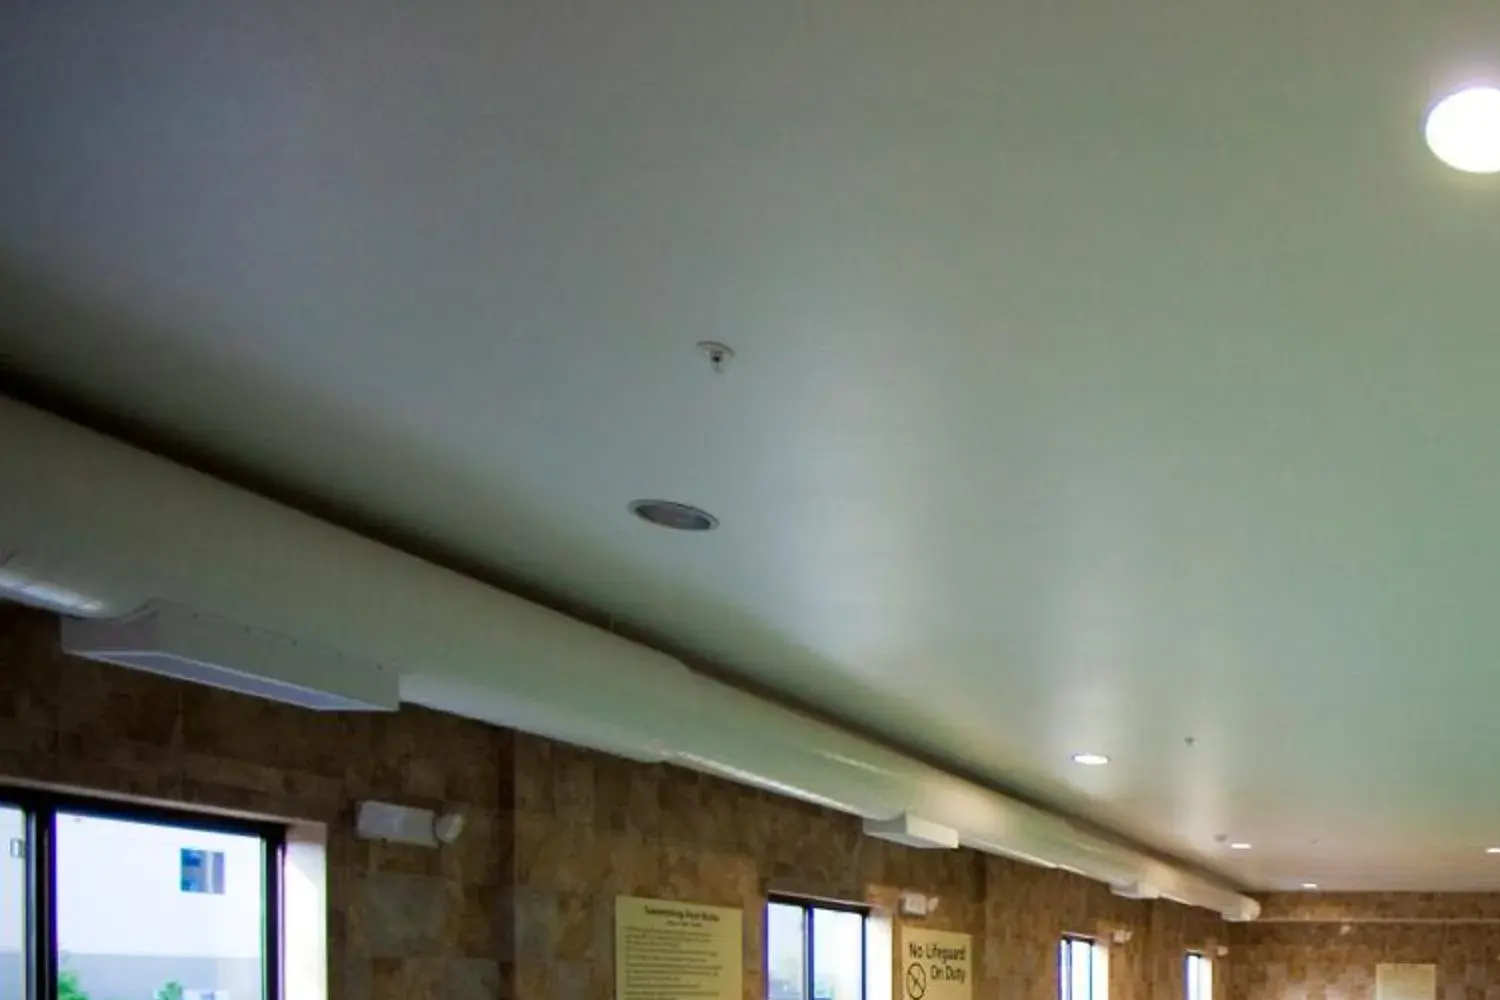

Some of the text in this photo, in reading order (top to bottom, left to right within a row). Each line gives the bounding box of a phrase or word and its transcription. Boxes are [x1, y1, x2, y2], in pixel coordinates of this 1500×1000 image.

[909, 943, 966, 964] No Lifeguard
[930, 964, 967, 984] On Duty
